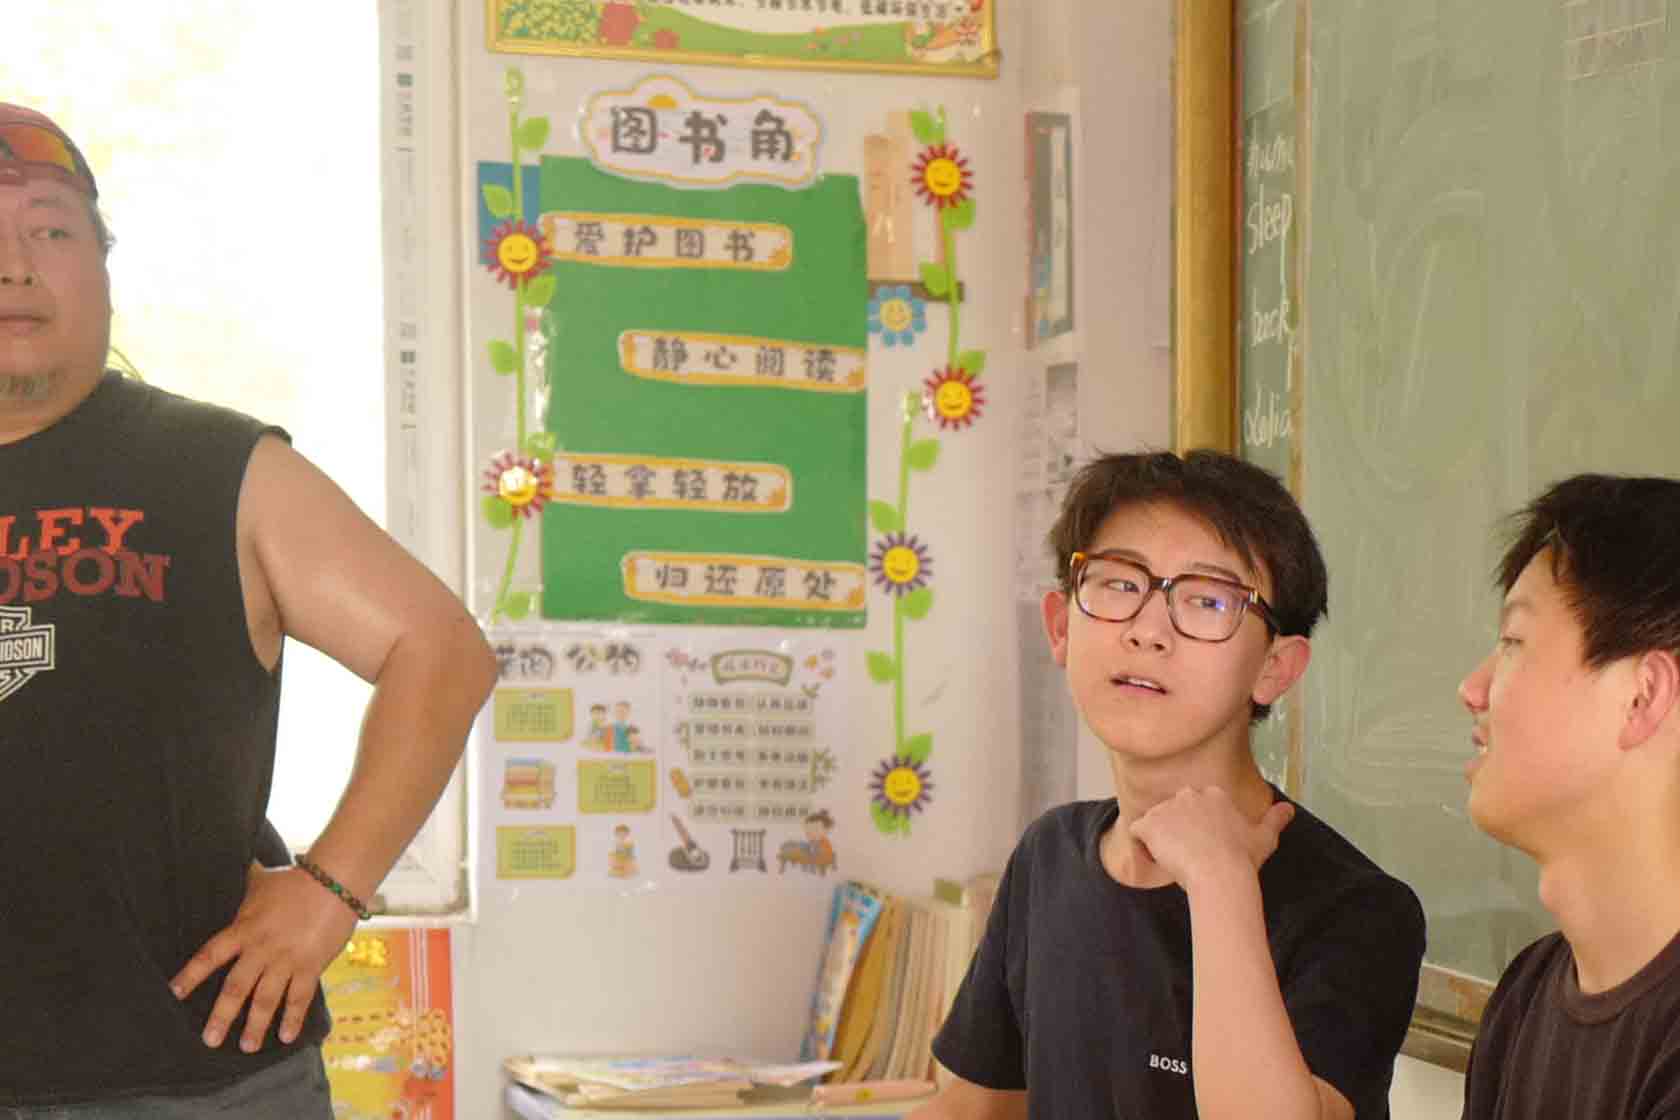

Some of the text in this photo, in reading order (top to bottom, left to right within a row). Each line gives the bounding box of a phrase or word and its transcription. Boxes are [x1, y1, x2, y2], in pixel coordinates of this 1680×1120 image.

[610, 105, 793, 164] 图书角
[573, 220, 756, 263] 爱护图书
[652, 337, 837, 383] 静心阅读
[571, 463, 759, 501] 轻拿轻放
[655, 562, 839, 601] 归还原处
[1150, 1054, 1188, 1076] BOSS
